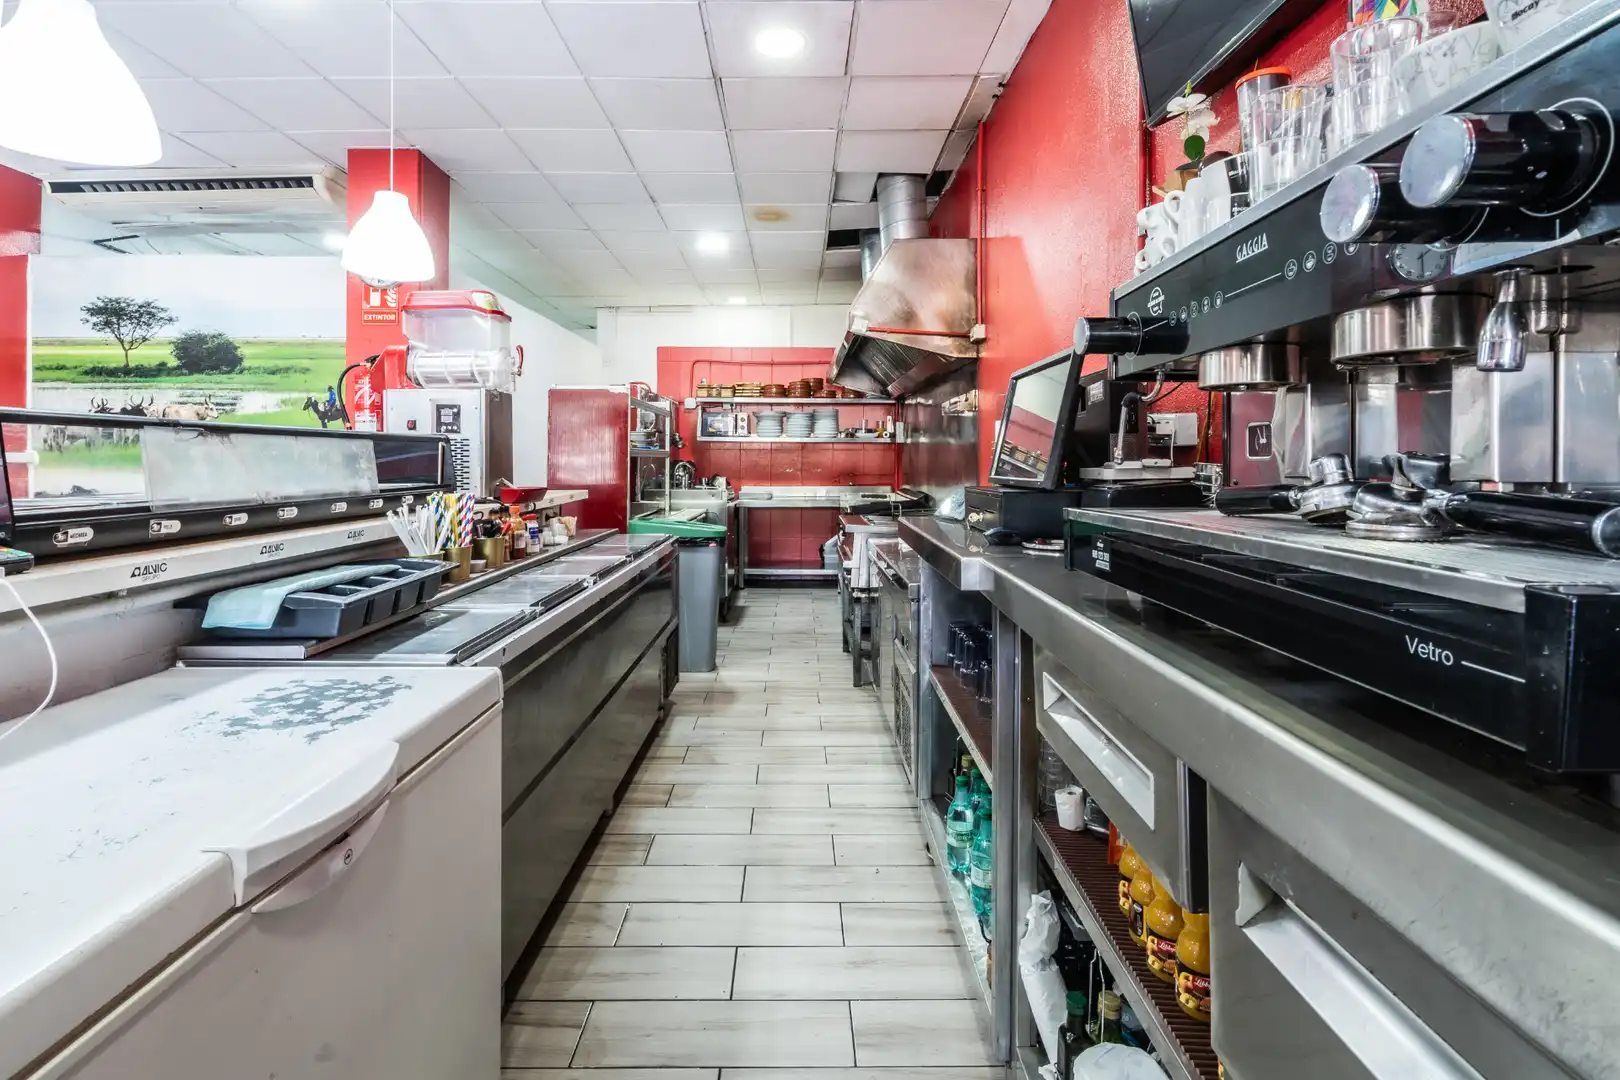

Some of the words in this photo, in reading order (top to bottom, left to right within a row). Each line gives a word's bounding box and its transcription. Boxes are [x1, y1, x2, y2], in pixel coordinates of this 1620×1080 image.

[1235, 232, 1268, 262] GAGGIA
[363, 313, 396, 321] EXTINTOR
[267, 542, 285, 554] ALVIC
[141, 562, 168, 577] ALVIC
[141, 573, 161, 582] GRUPO
[1405, 634, 1454, 666] Vetro
[1159, 941, 1177, 953] Libby
[1194, 977, 1211, 990] Libb
